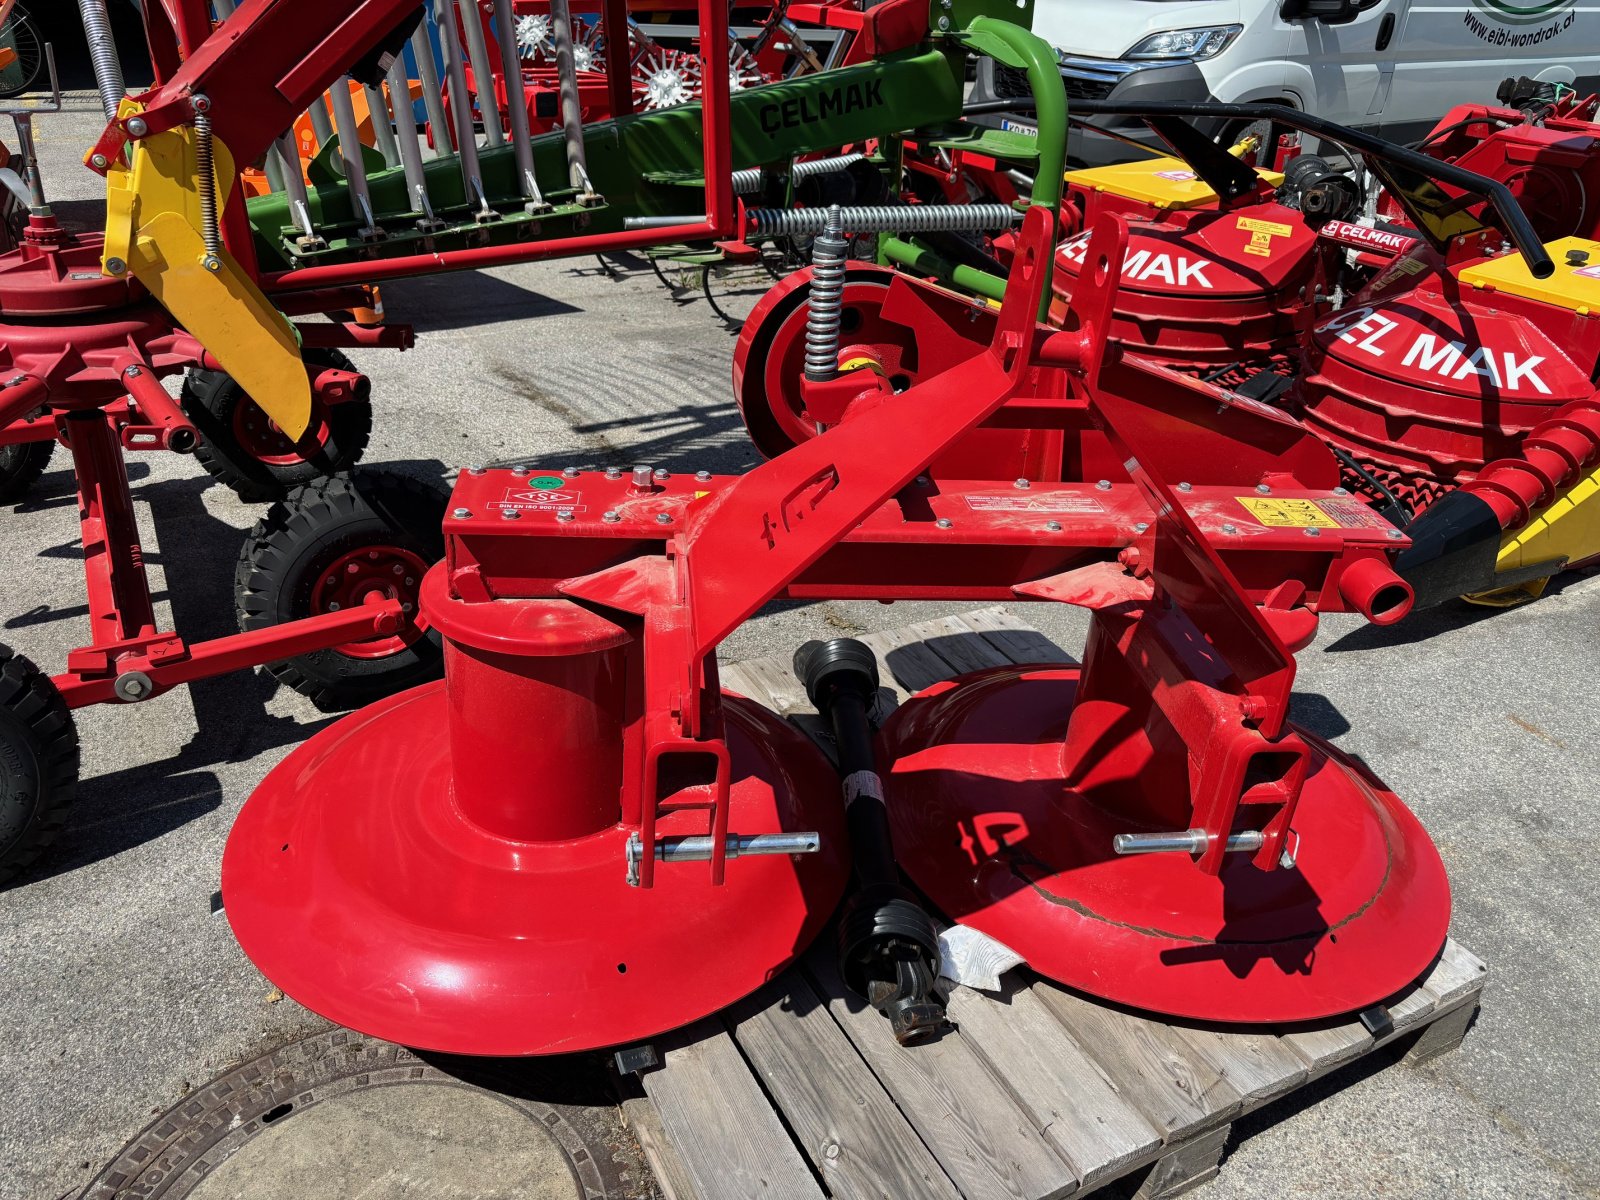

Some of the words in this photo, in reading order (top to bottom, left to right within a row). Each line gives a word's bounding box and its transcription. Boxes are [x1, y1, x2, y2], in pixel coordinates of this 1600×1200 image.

[1463, 9, 1576, 47] www.eibl-wondrak.at
[760, 78, 883, 139] ÇELMAK
[1340, 224, 1404, 247] ÇELMAK
[1121, 246, 1214, 289] MAK
[1400, 333, 1553, 394] MAK
[528, 492, 559, 501] TSE
